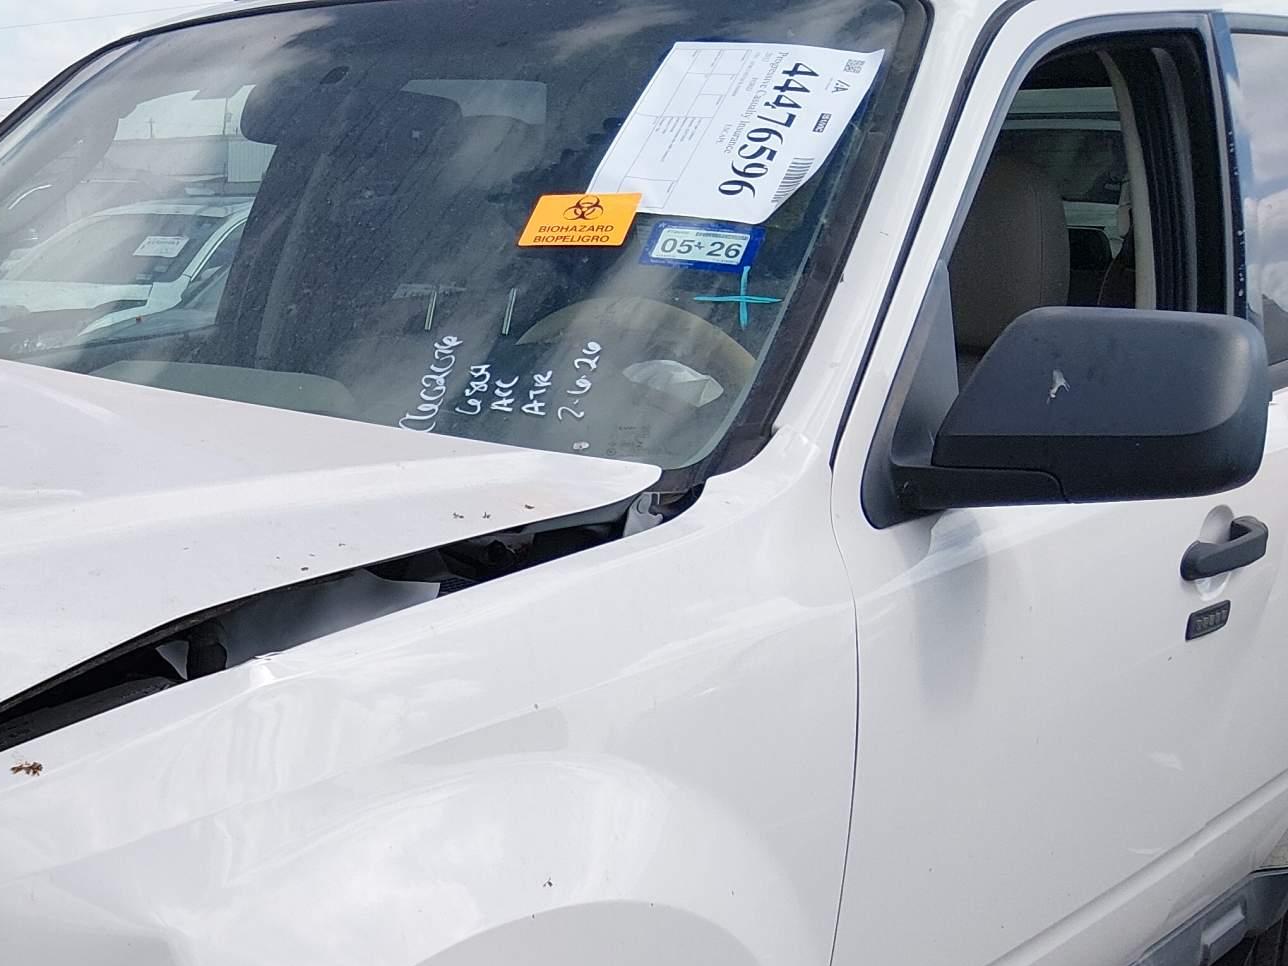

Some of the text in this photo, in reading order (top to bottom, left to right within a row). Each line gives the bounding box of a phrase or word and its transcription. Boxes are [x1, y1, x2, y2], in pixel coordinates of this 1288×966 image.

[759, 50, 789, 89] Progressive
[741, 89, 767, 118] Casualty
[718, 62, 820, 198] 44476596
[724, 120, 751, 153] Insurance
[532, 235, 610, 243] BIOPELIGRO
[538, 224, 614, 233] BIOHAZARD
[660, 238, 742, 259] 05 26
[490, 376, 519, 412] ACC
[521, 370, 553, 415] ATR
